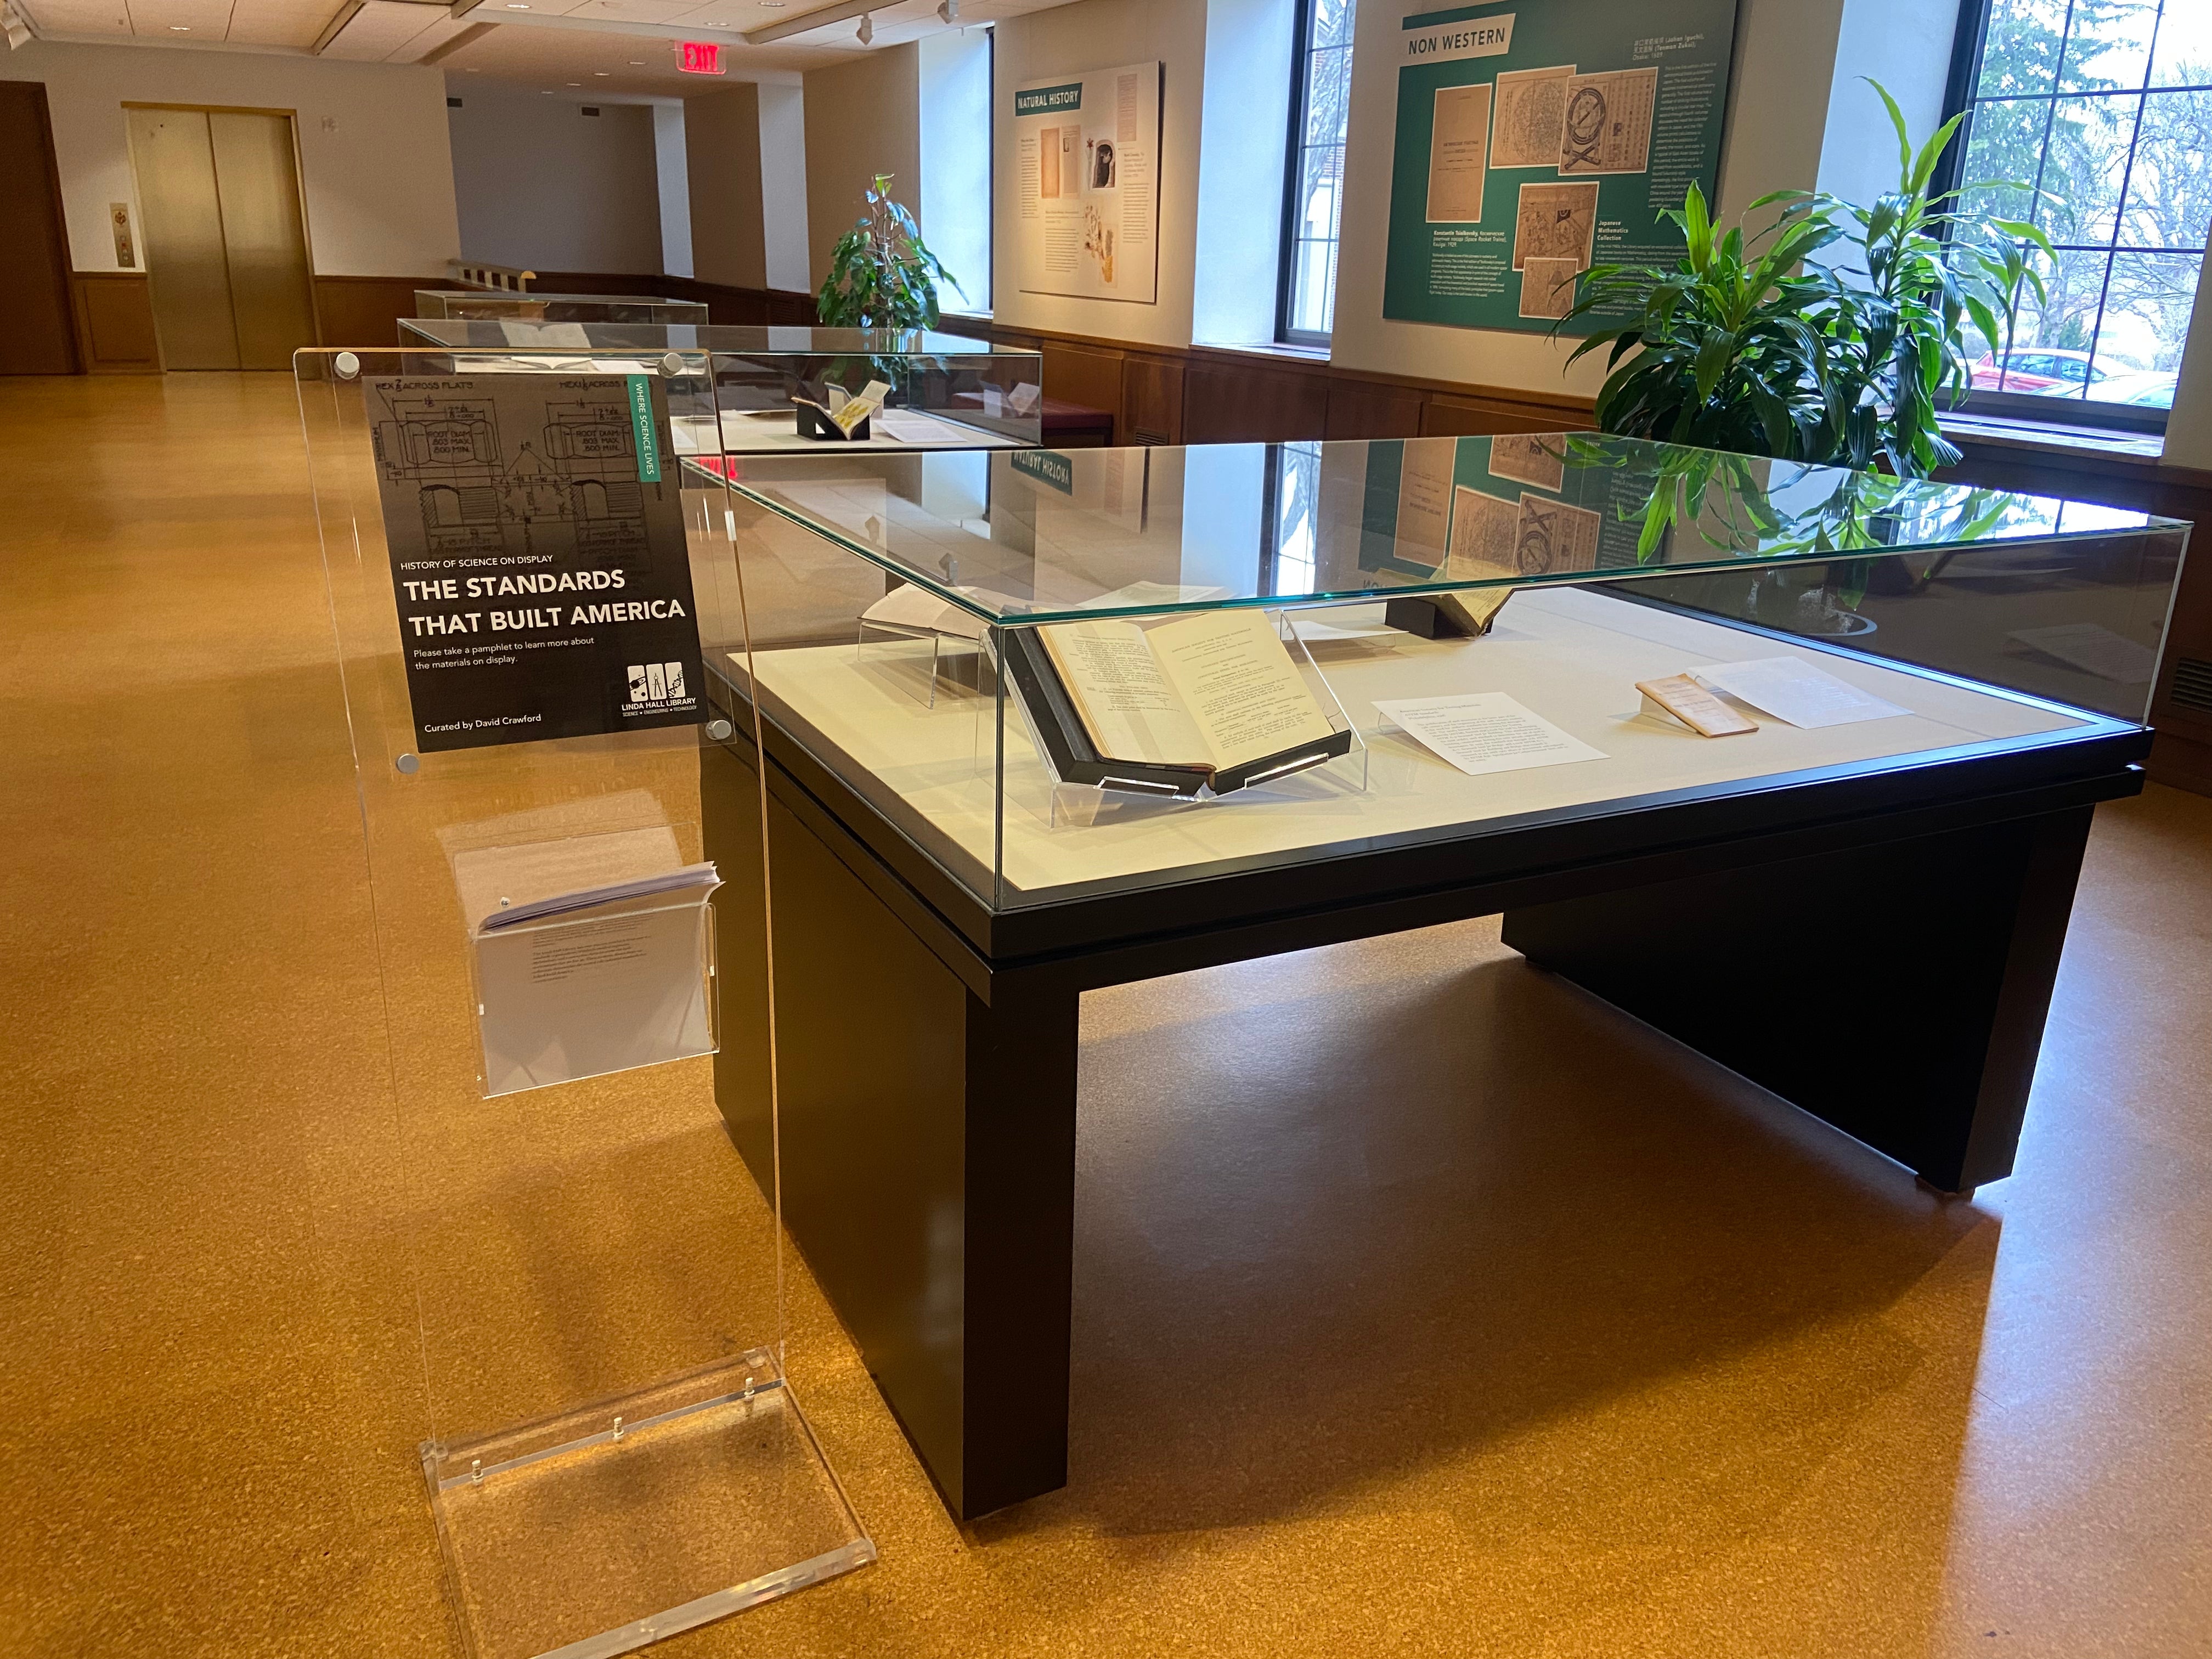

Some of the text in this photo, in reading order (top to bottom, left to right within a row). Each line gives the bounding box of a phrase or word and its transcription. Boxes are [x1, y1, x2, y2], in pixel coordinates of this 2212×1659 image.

[1409, 27, 1505, 54] NON WESTERN
[684, 43, 719, 71] EXIT
[1018, 91, 1079, 109] NATURAL HISTORY
[635, 383, 654, 475] WHERE SCIENCE LIVES
[400, 555, 553, 571] HISTORY OF SCIENCE ON DISPLAY
[403, 569, 625, 601] THE STANDARDS
[408, 599, 686, 636] THAT BUILT AMERICA
[414, 649, 442, 658] Please
[444, 647, 462, 656] take
[472, 643, 512, 656] pamphlet
[525, 640, 545, 649] learn
[571, 637, 595, 646] about
[432, 658, 471, 669] materials
[486, 655, 518, 665] display.
[622, 697, 696, 711] LINDA HALL LIBRARY
[424, 714, 541, 733] Curated by David Crawford
